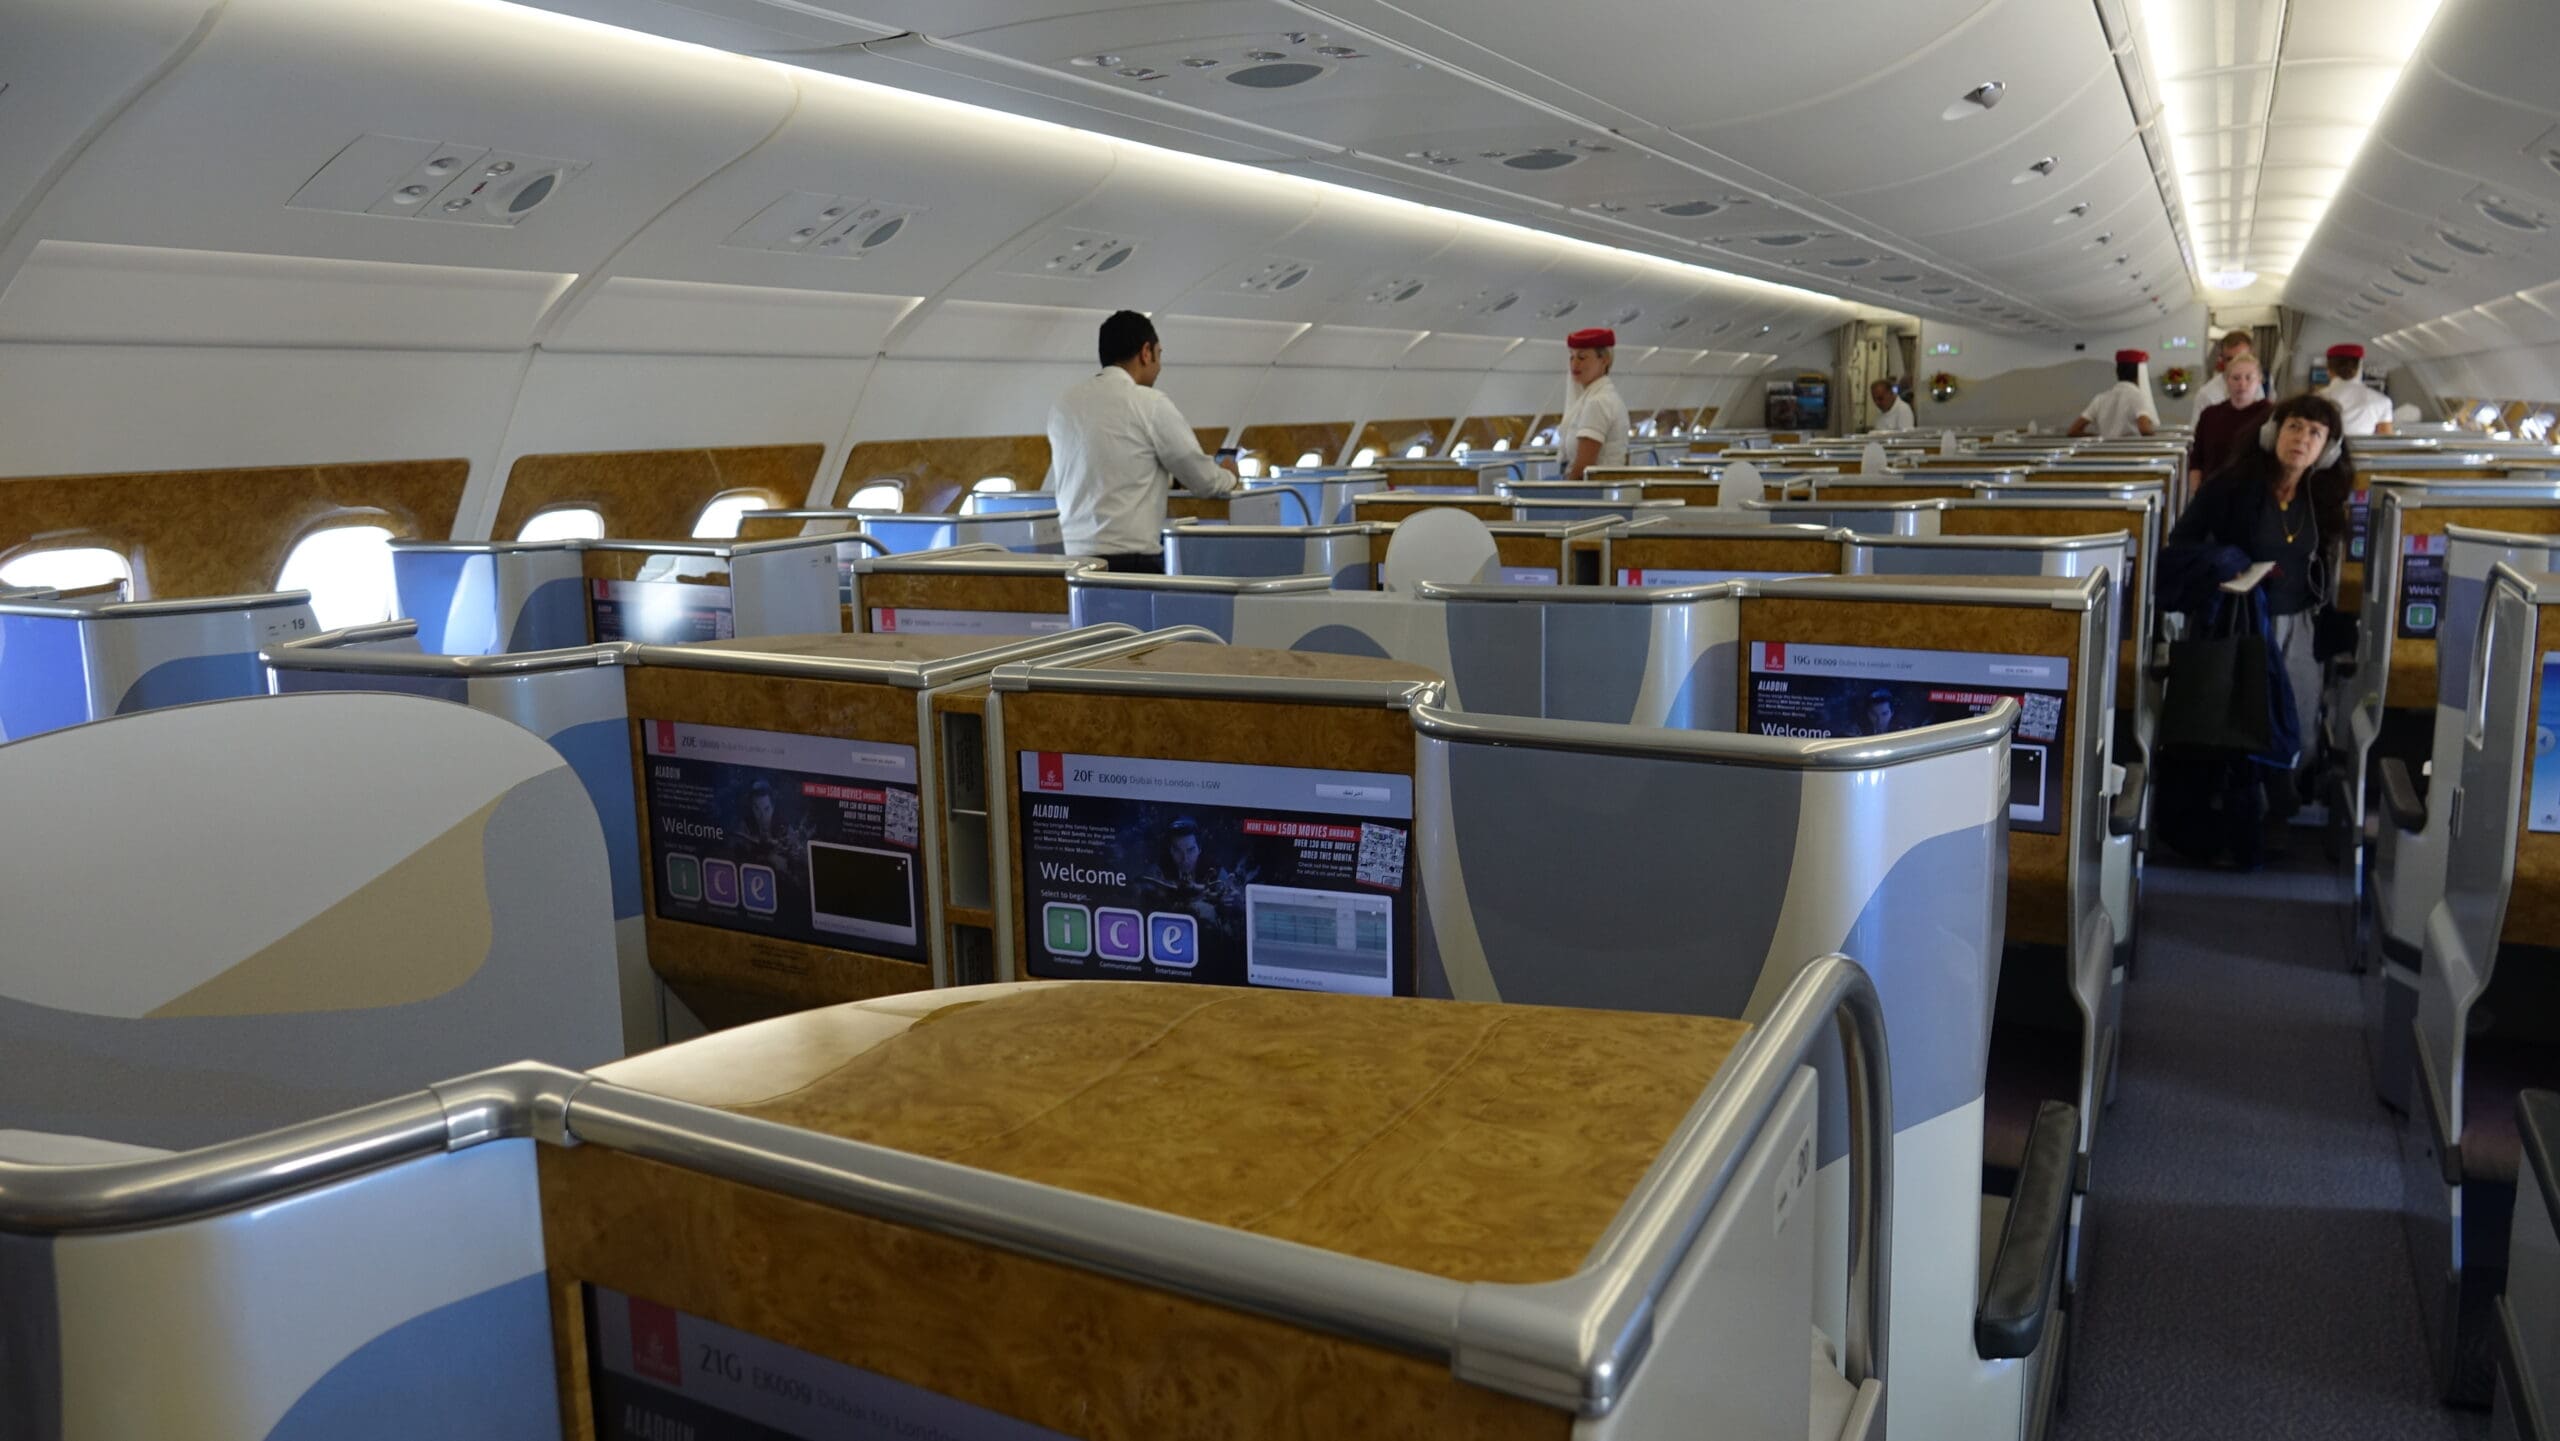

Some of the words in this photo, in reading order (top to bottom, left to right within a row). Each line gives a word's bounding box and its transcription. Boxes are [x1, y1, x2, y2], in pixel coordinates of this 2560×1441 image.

[292, 618, 305, 631] 19
[1758, 680, 1788, 692] ALADDIN
[1761, 722, 1831, 738] Welcome
[1073, 770, 1094, 783] 20F
[1099, 773, 1128, 785] EK009
[1130, 776, 1153, 786] Dubai
[1154, 778, 1163, 786] to
[1164, 778, 1195, 788] London
[1033, 804, 1070, 820] ALADDIN
[662, 817, 724, 841] Welcome
[1278, 823, 1297, 836] 1500
[1298, 824, 1328, 838] MOVIES
[1040, 862, 1127, 887] Welcome
[1041, 889, 1060, 898] Select
[1061, 891, 1068, 899] to
[700, 1343, 743, 1384] 21G
[752, 1367, 812, 1406] EK009
[817, 1386, 867, 1421] Dubai
[870, 1409, 890, 1429] to
